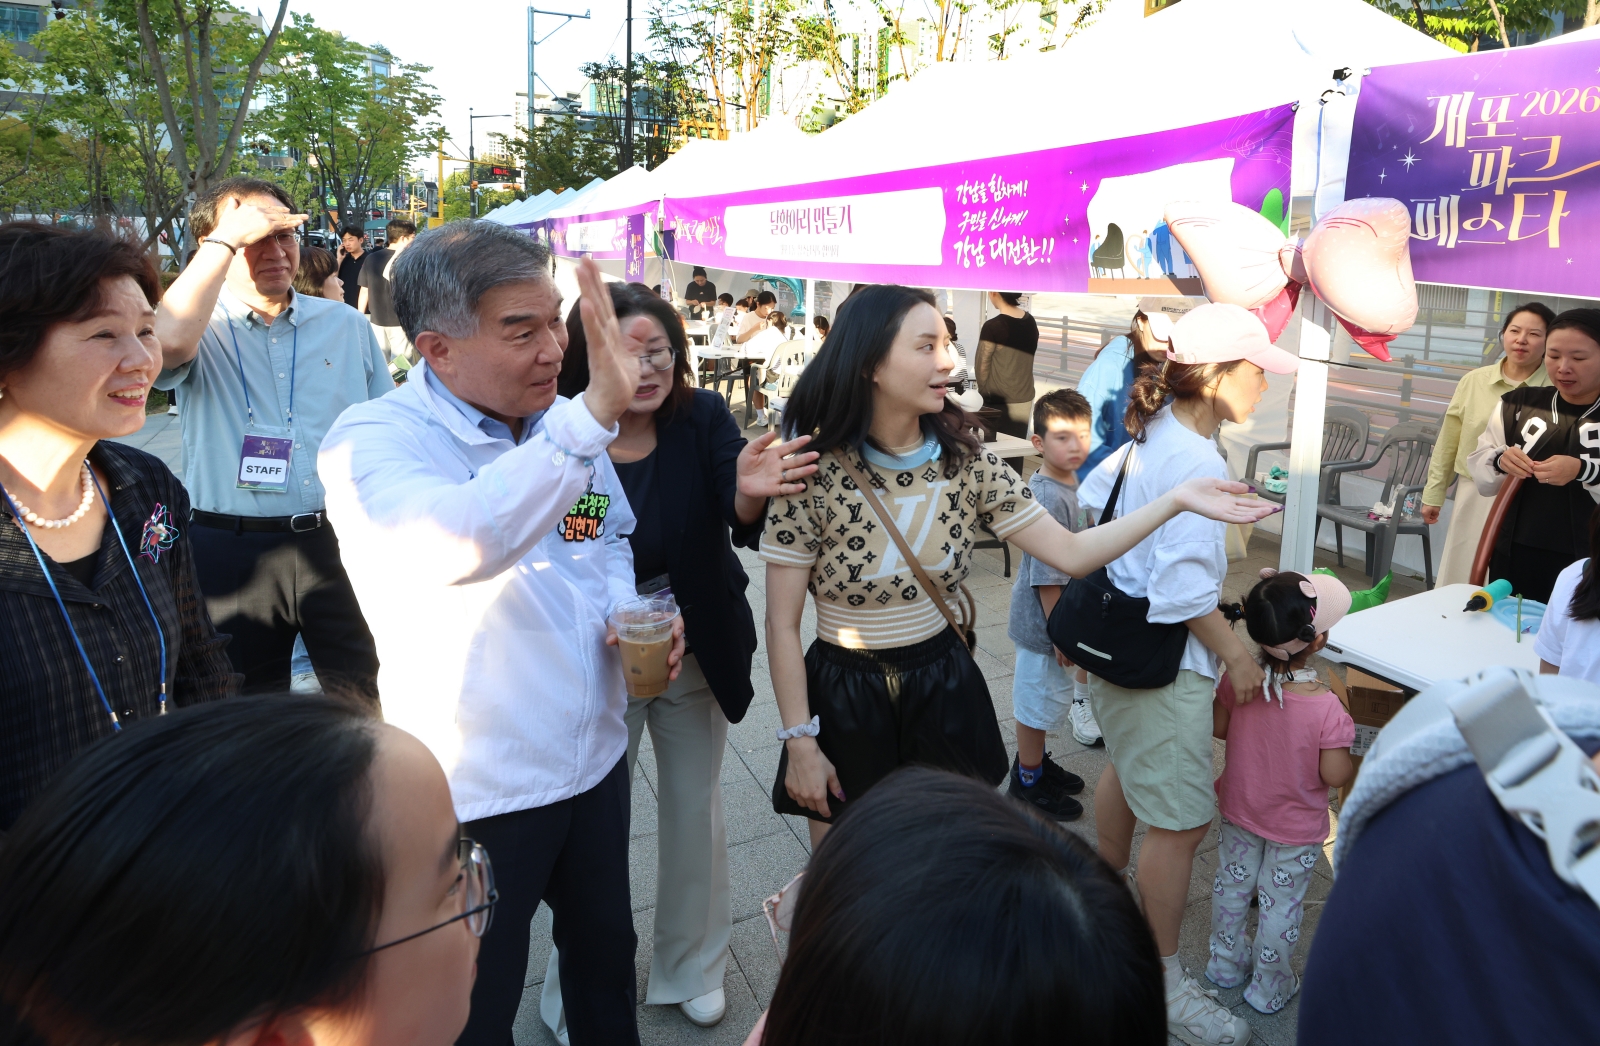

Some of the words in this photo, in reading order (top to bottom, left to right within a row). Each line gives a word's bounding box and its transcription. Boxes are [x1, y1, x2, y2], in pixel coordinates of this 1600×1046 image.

[1420, 91, 1519, 148] 개포
[1520, 86, 1600, 117] 2026
[1461, 136, 1600, 195] 파크
[956, 180, 988, 205] 강남을
[988, 173, 1028, 203] 힘차게!
[770, 207, 811, 236] 달항아리
[813, 204, 853, 235] 만들기
[958, 210, 988, 235] 구민을
[988, 206, 1028, 231] 신나게!
[1410, 189, 1571, 249] 페스타
[953, 235, 986, 269] 강남
[988, 233, 1055, 266] 대전환!!
[246, 464, 282, 475] STAFF
[569, 493, 610, 518] 구청장
[565, 516, 597, 540] 김현기
